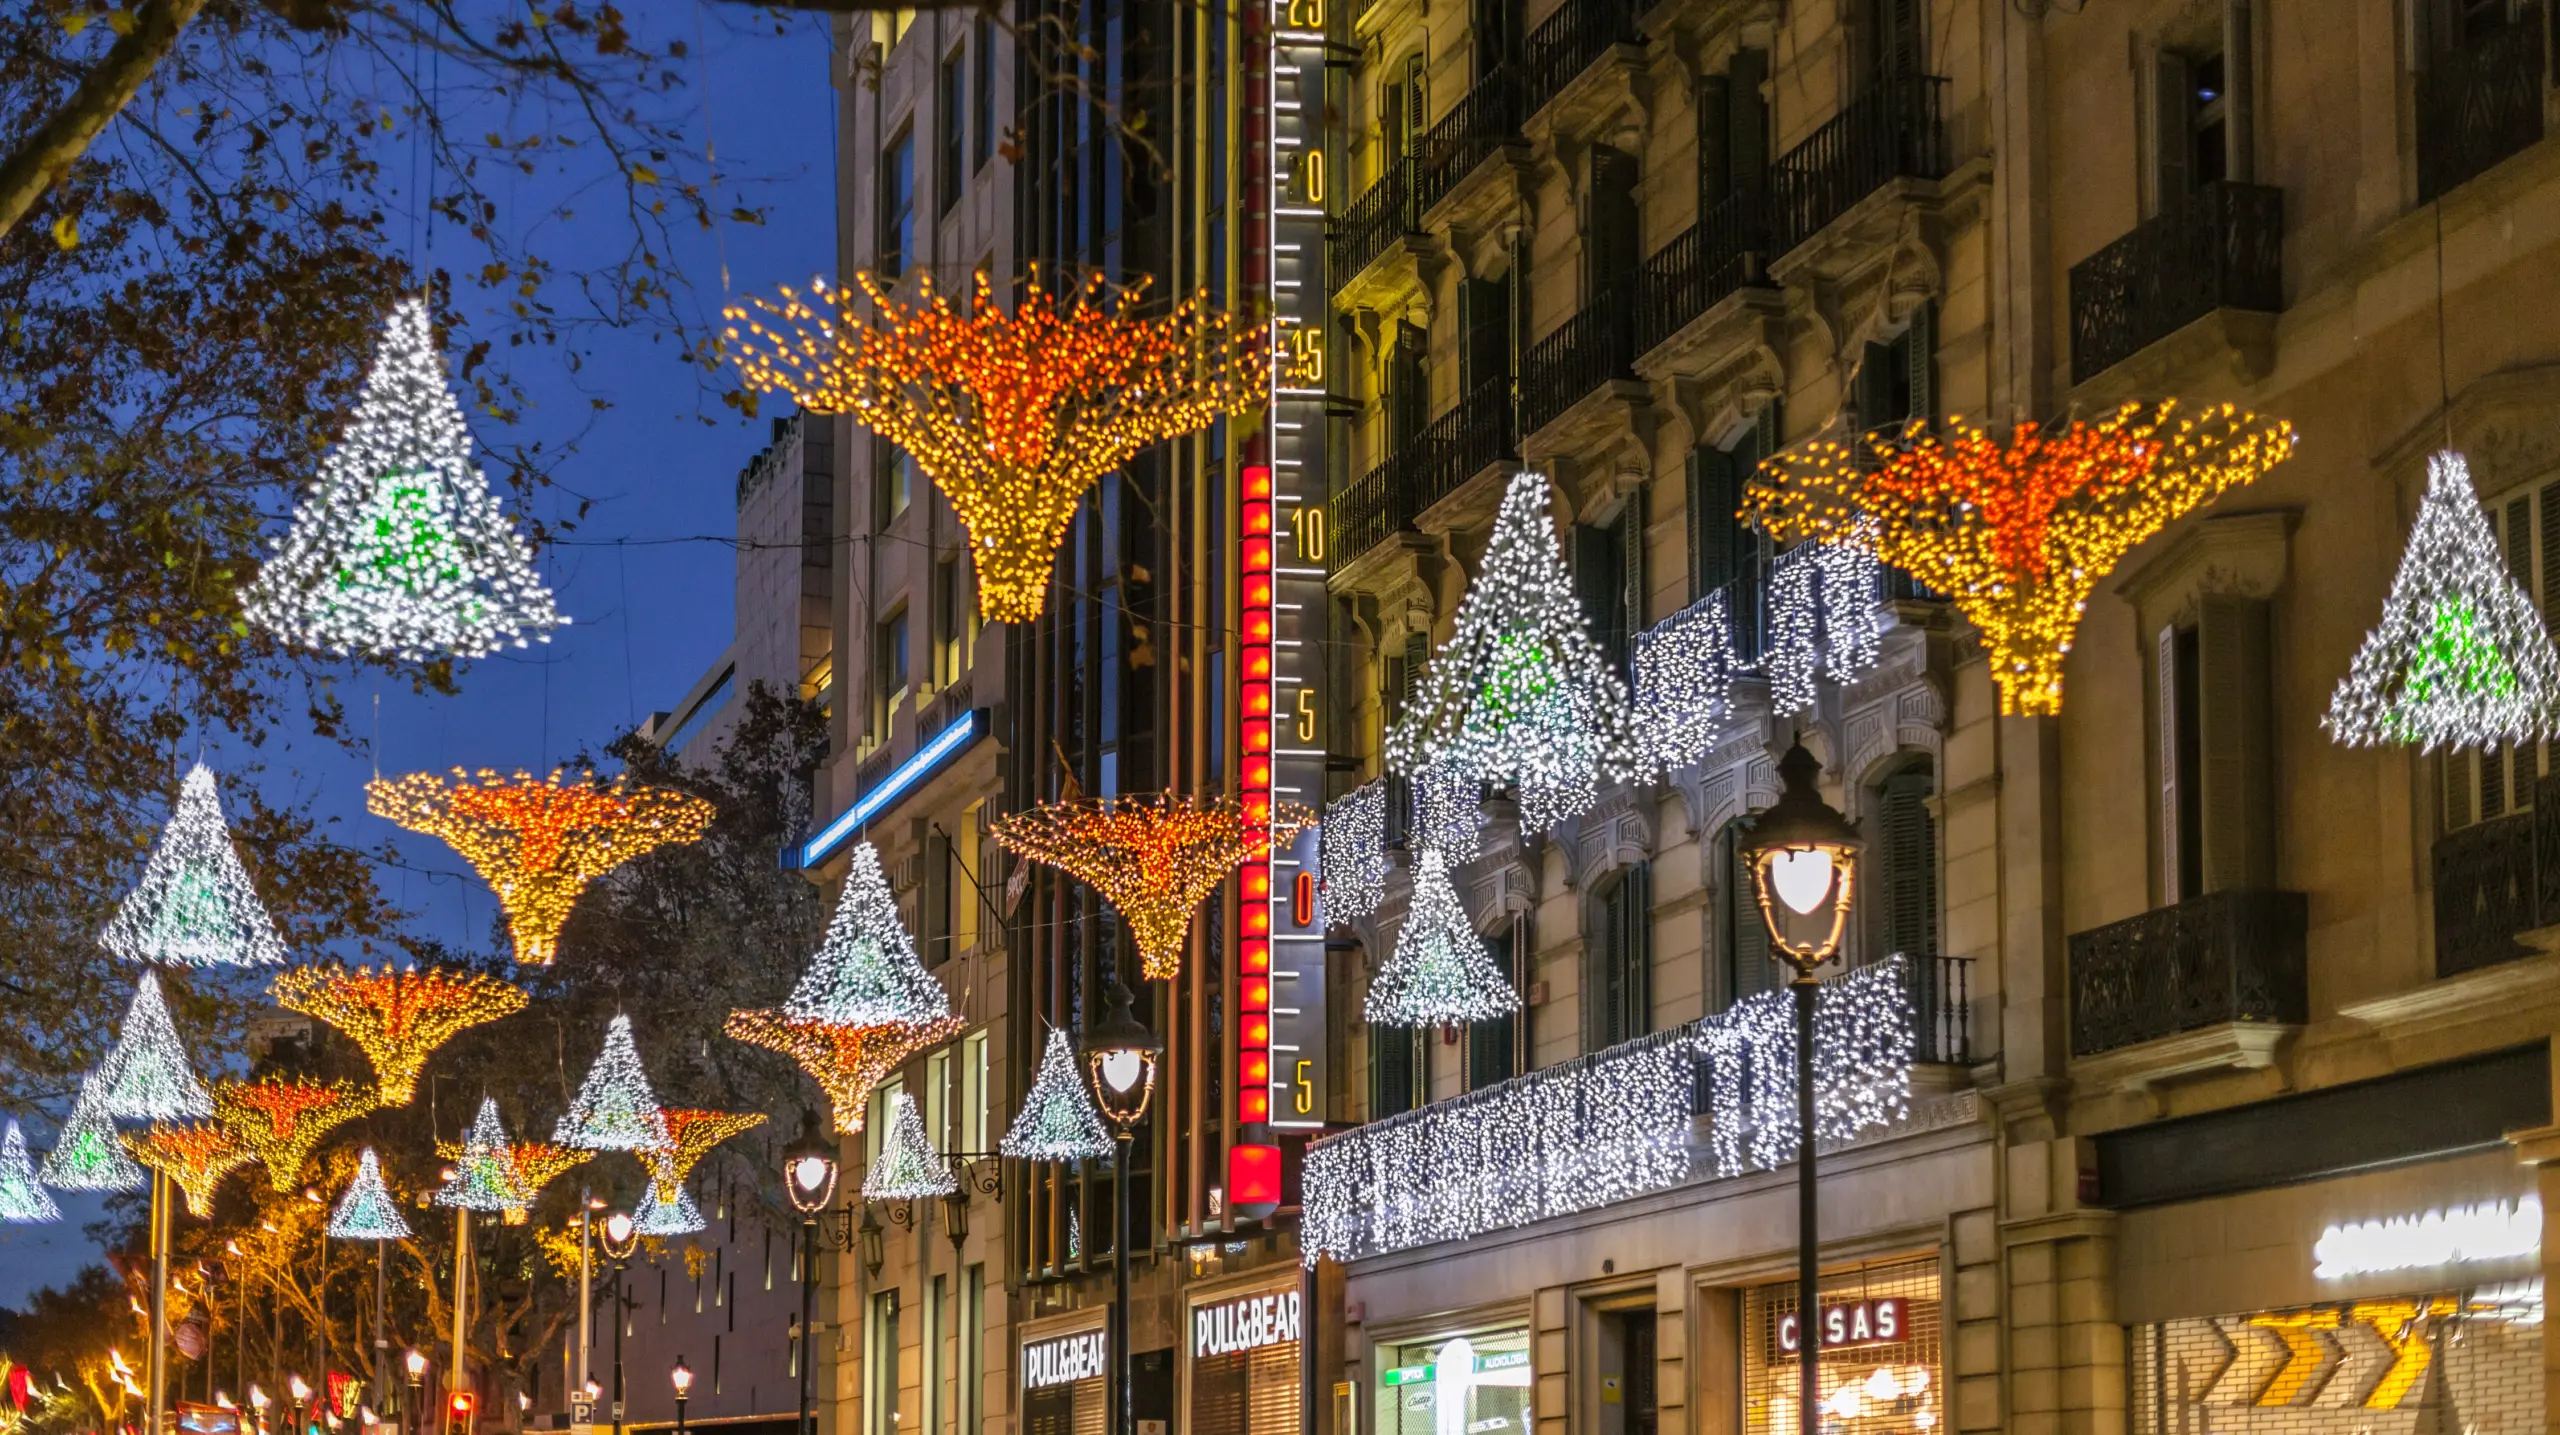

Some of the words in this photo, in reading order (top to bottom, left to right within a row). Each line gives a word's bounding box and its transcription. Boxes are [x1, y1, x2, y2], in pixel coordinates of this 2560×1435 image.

[1292, 328, 1321, 380] 15
[1292, 508, 1323, 560] 10
[1300, 689, 1314, 741] 5
[1297, 871, 1313, 925] 0
[1297, 1060, 1312, 1114] 5
[1197, 1290, 1300, 1358] PULL&BEAR
[1781, 1302, 1896, 1350] CSAS
[574, 1404, 589, 1422] P
